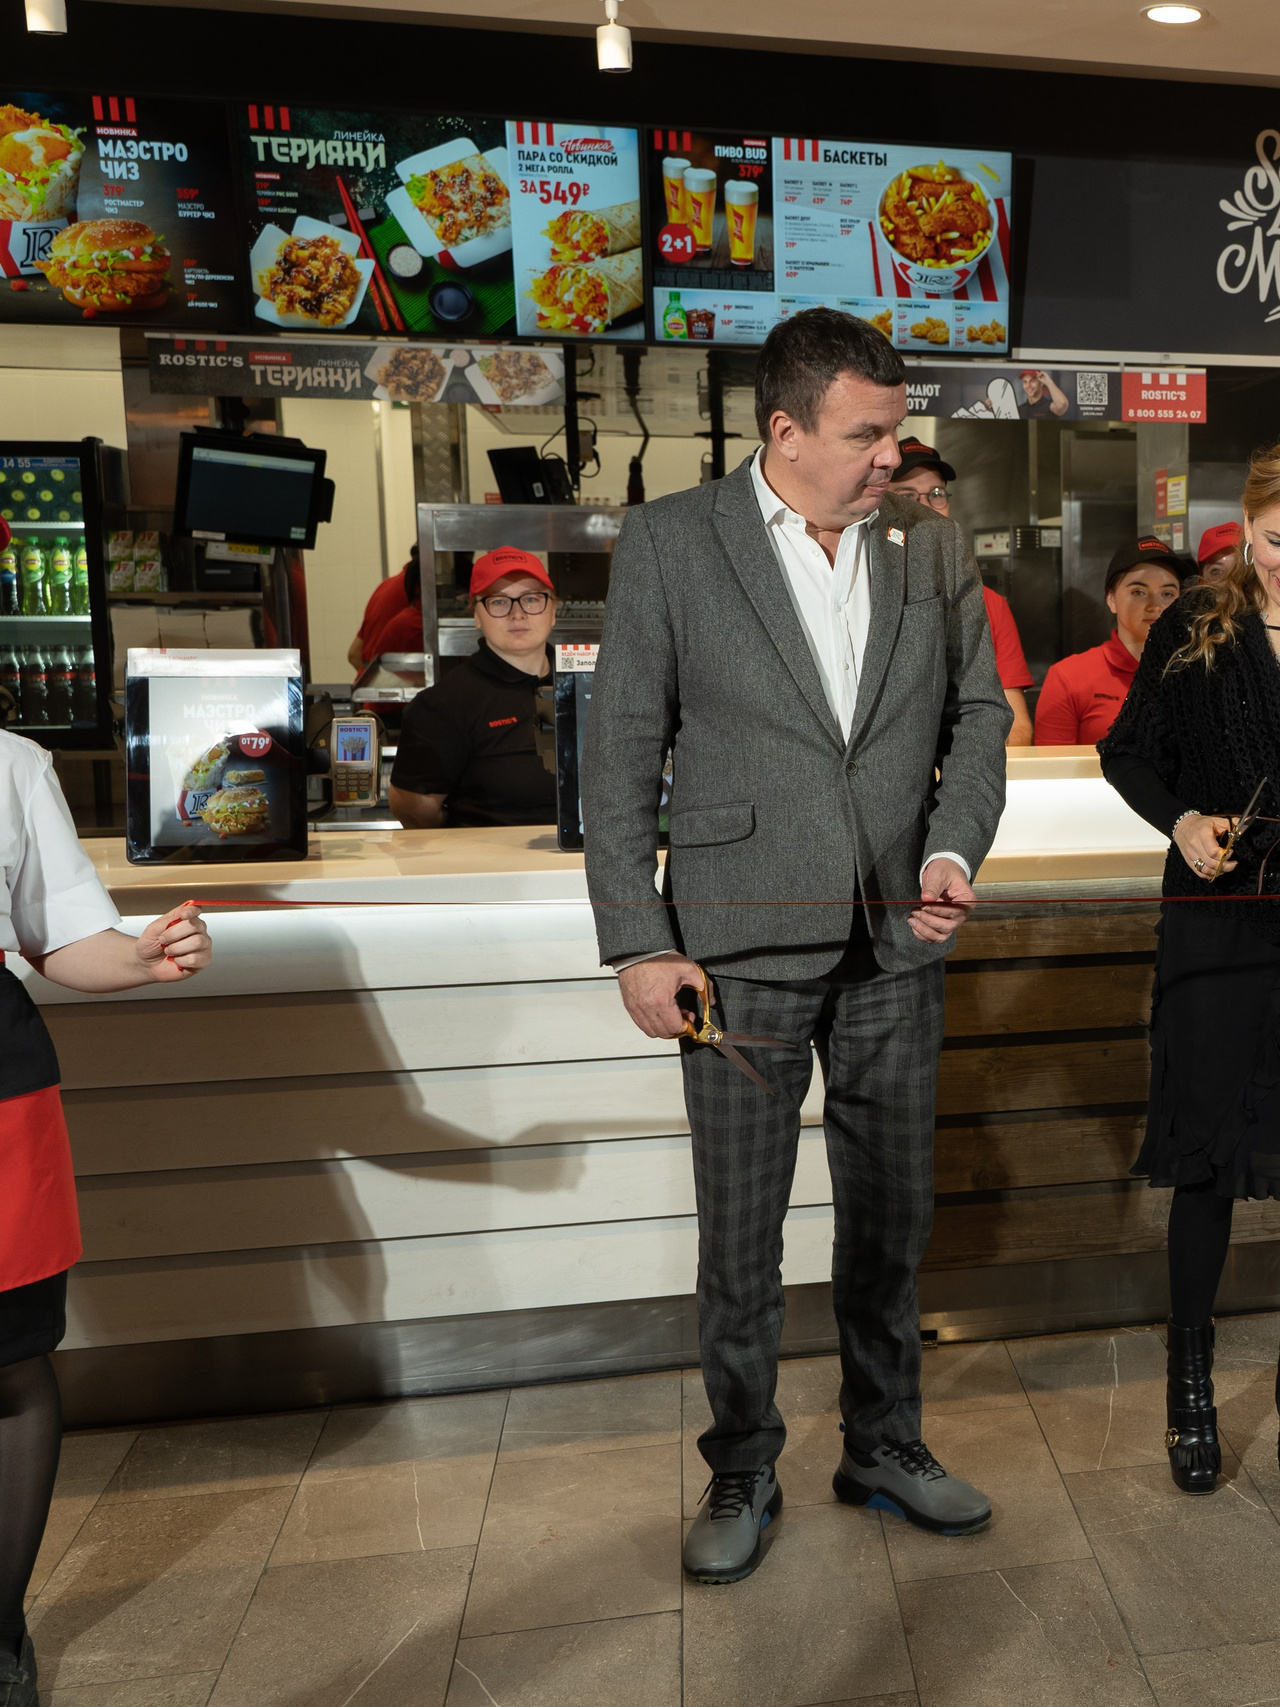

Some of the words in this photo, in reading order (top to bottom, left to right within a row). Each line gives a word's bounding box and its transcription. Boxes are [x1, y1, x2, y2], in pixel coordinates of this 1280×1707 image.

[97, 127, 137, 136] НОВИНКА
[333, 130, 386, 143] ЛИНЕЙКА
[98, 138, 188, 162] МАЭСТРО
[250, 135, 386, 173] ТЕРИЯКИ
[714, 145, 743, 158] ПИВО
[745, 148, 767, 160] BUD
[518, 150, 546, 162] ПАРА
[549, 152, 563, 163] СО
[566, 152, 618, 167] СКИДКОЙ
[823, 149, 887, 166] БАСКЕТЫ
[100, 160, 140, 180] ЧИЗ
[518, 164, 523, 172] 2
[525, 164, 545, 173] МЕГА
[547, 165, 574, 174] РОЛЛА
[520, 180, 537, 194] ЗА
[661, 234, 692, 253] 2+1
[159, 353, 244, 367] ROSTIC'S
[254, 354, 287, 362] НОВИНКА
[317, 358, 360, 367] ЛИНЕЙКА
[250, 365, 362, 392] ТЕРИЯКИ
[905, 383, 941, 397] МАЮТ
[1141, 389, 1187, 401] ROSTIC'S
[906, 397, 929, 411] ОТУ
[1128, 409, 1135, 417] 8
[1136, 409, 1155, 418] 800
[1157, 409, 1174, 418] 555
[1176, 410, 1188, 418] 24
[1189, 410, 1202, 419] 07
[183, 704, 256, 718] МАЭСТРО
[203, 719, 229, 731] ЧИ
